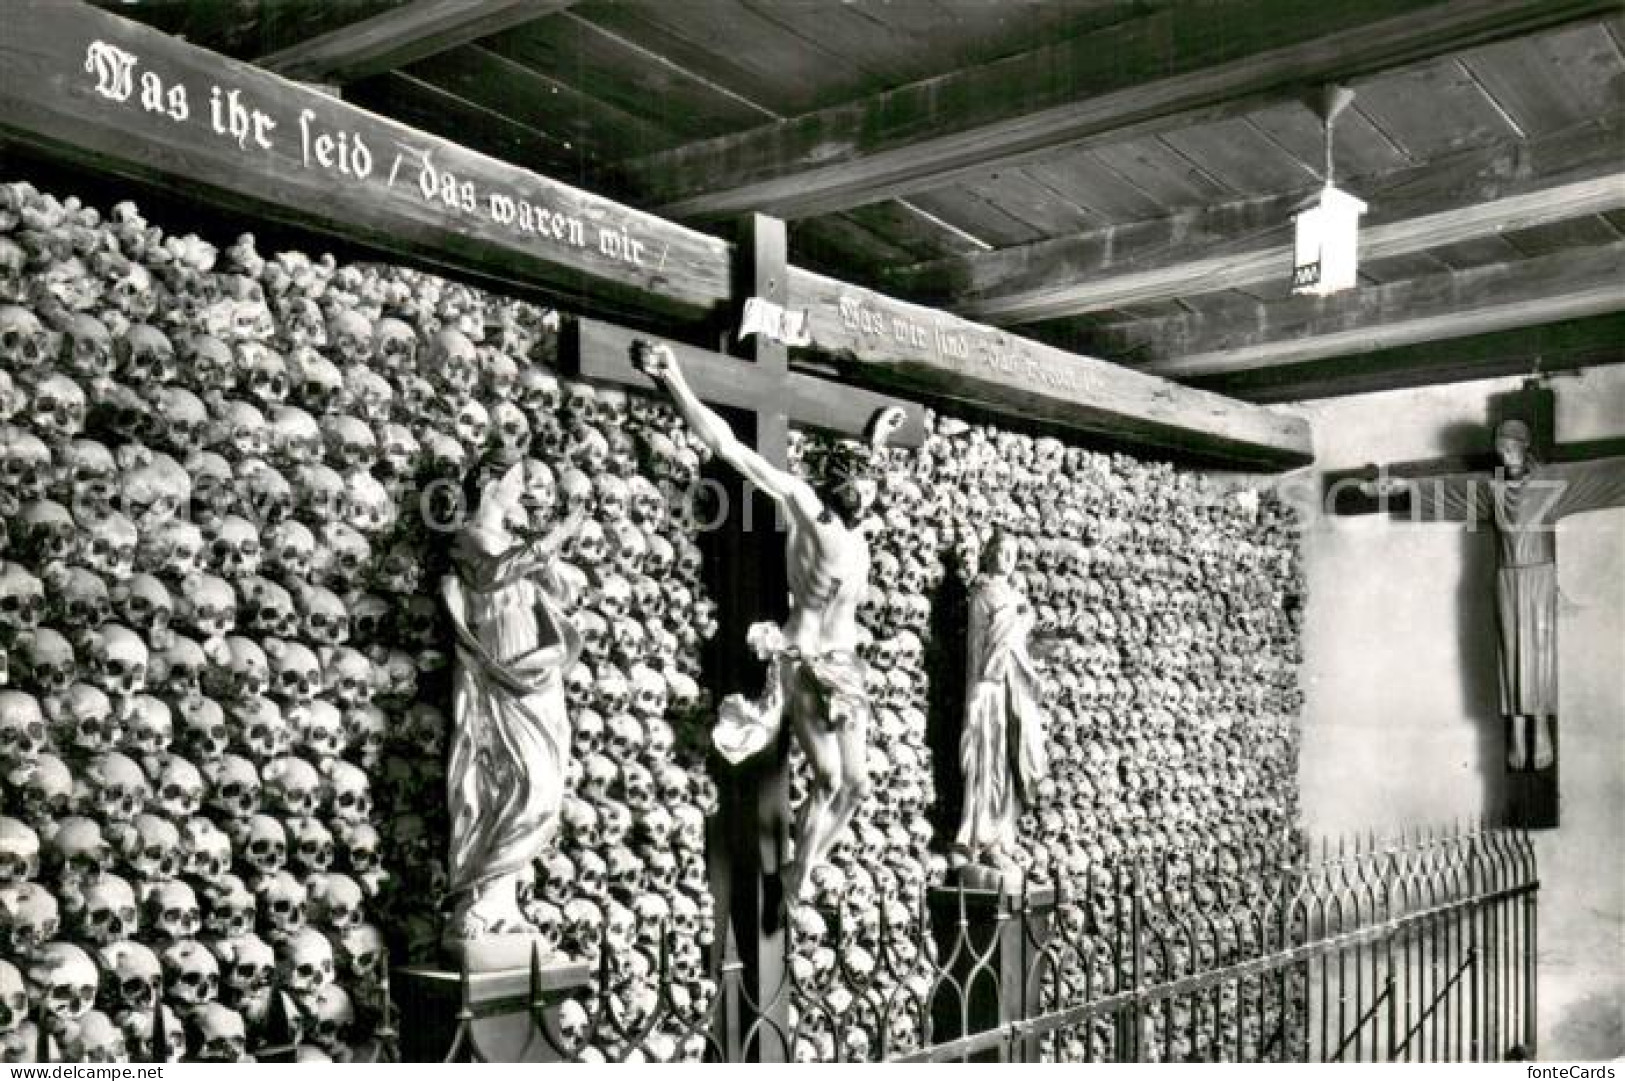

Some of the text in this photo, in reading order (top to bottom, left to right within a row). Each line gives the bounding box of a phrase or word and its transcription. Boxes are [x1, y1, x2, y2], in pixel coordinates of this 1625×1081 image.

[85, 40, 189, 122] Was
[209, 85, 277, 150] ihr
[419, 149, 476, 212] das
[489, 193, 585, 247] waren
[599, 224, 644, 265] wir
